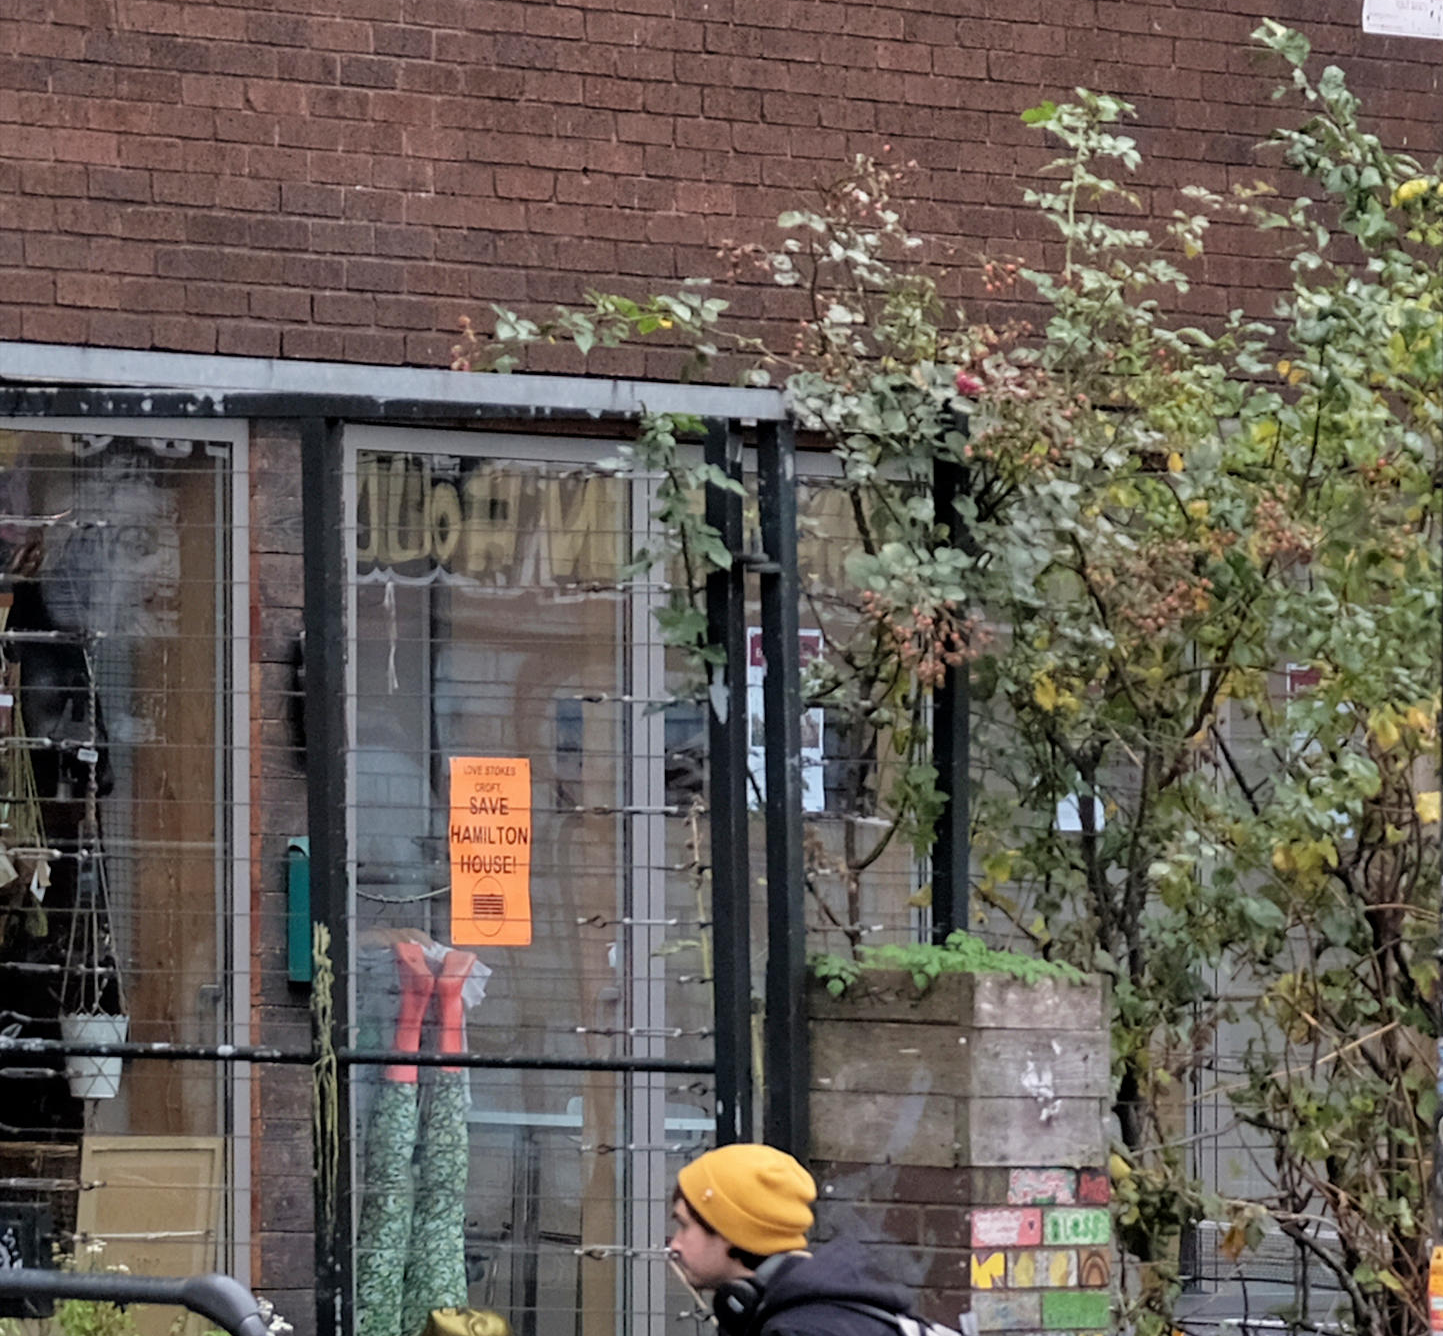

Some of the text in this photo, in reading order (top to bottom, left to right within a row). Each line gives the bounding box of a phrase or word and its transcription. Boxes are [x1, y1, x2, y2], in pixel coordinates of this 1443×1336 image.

[464, 765, 516, 777] LOVE STOKES
[469, 797, 509, 816] SAVE
[451, 826, 528, 845] HAMILTON
[460, 855, 517, 874] HOUSE!
